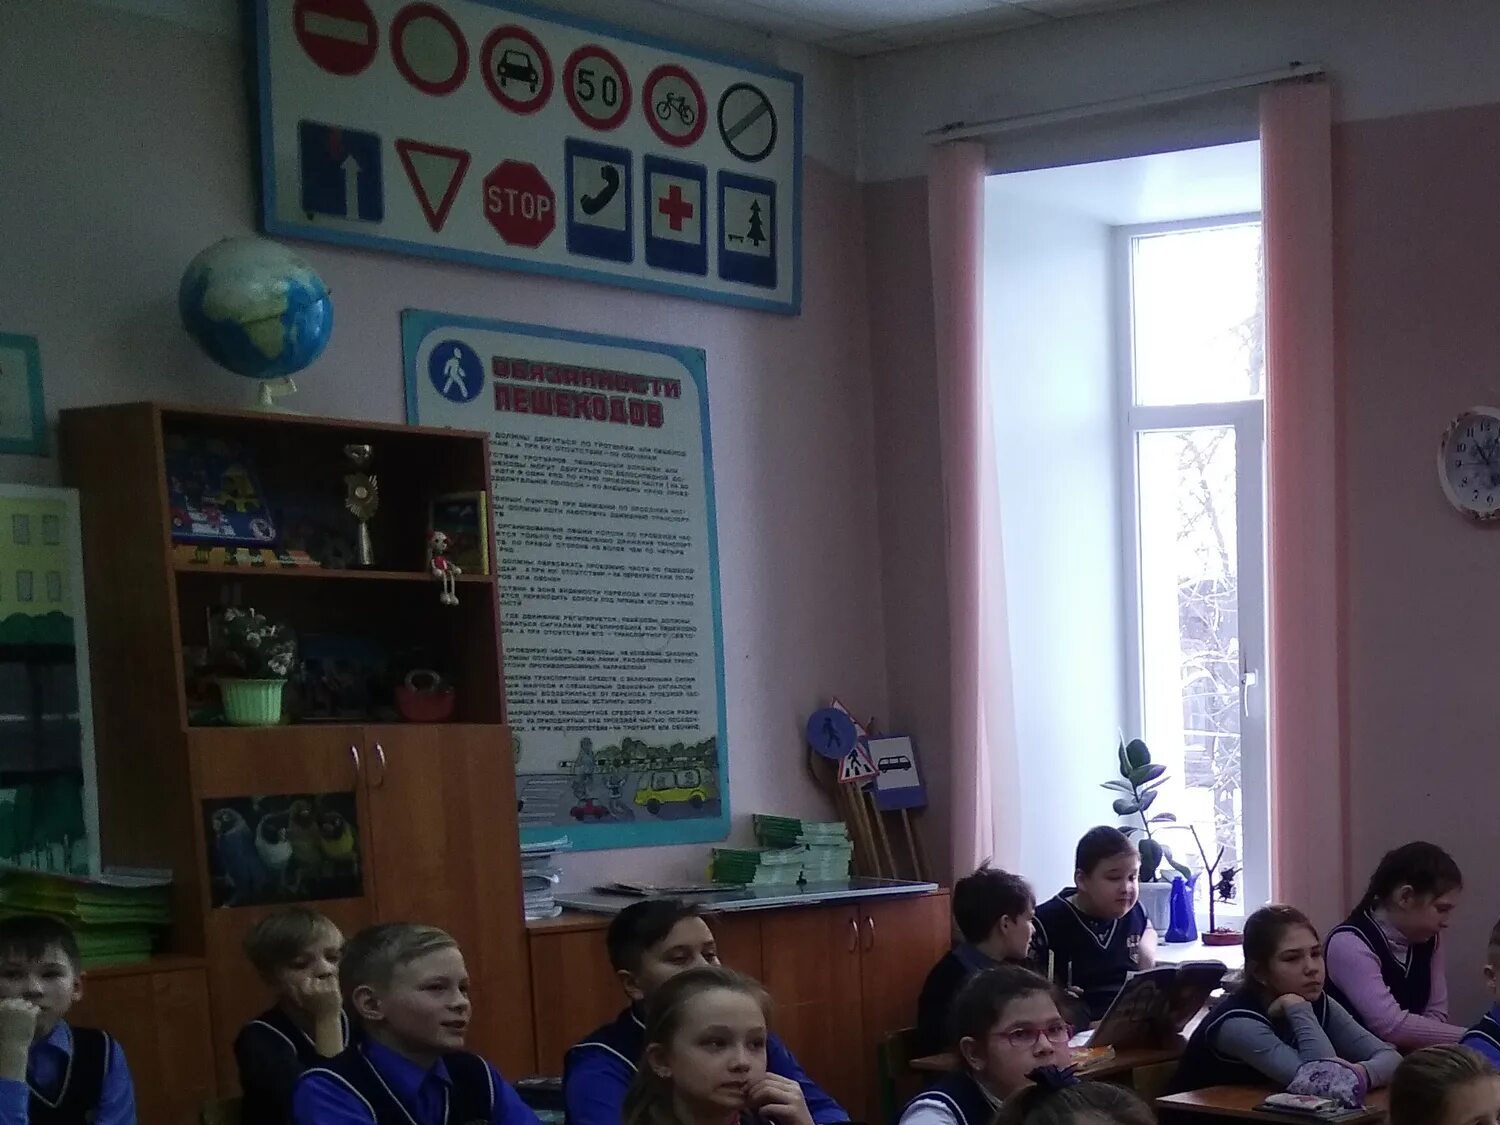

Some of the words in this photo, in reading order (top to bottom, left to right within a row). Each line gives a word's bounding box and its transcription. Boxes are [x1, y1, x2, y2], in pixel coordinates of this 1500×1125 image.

[577, 68, 618, 107] 50
[488, 185, 550, 223] STOP
[494, 383, 664, 428] ПЕШЕХОДОВ
